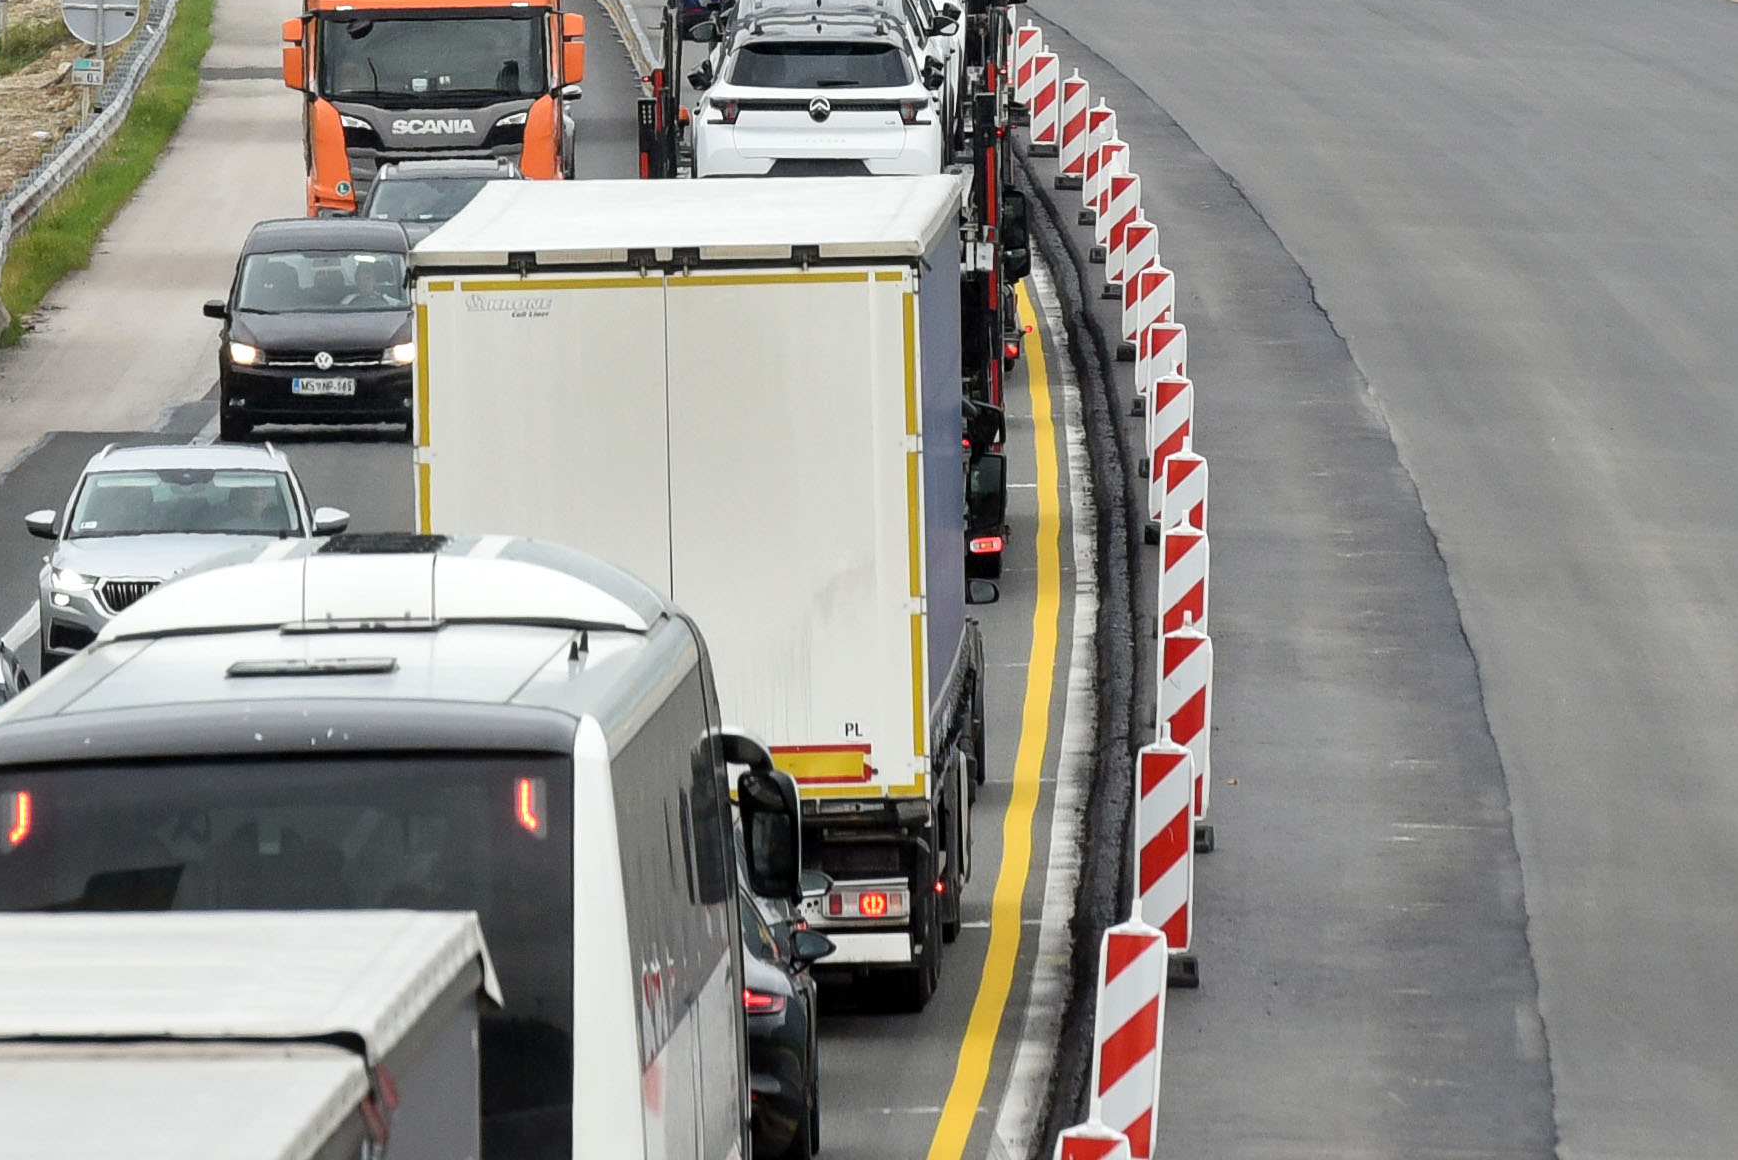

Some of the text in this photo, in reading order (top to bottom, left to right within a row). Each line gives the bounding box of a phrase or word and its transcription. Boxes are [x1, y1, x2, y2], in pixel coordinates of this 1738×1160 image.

[391, 118, 476, 135] SCANIA
[485, 296, 553, 311] KRONE
[845, 722, 863, 737] PL
